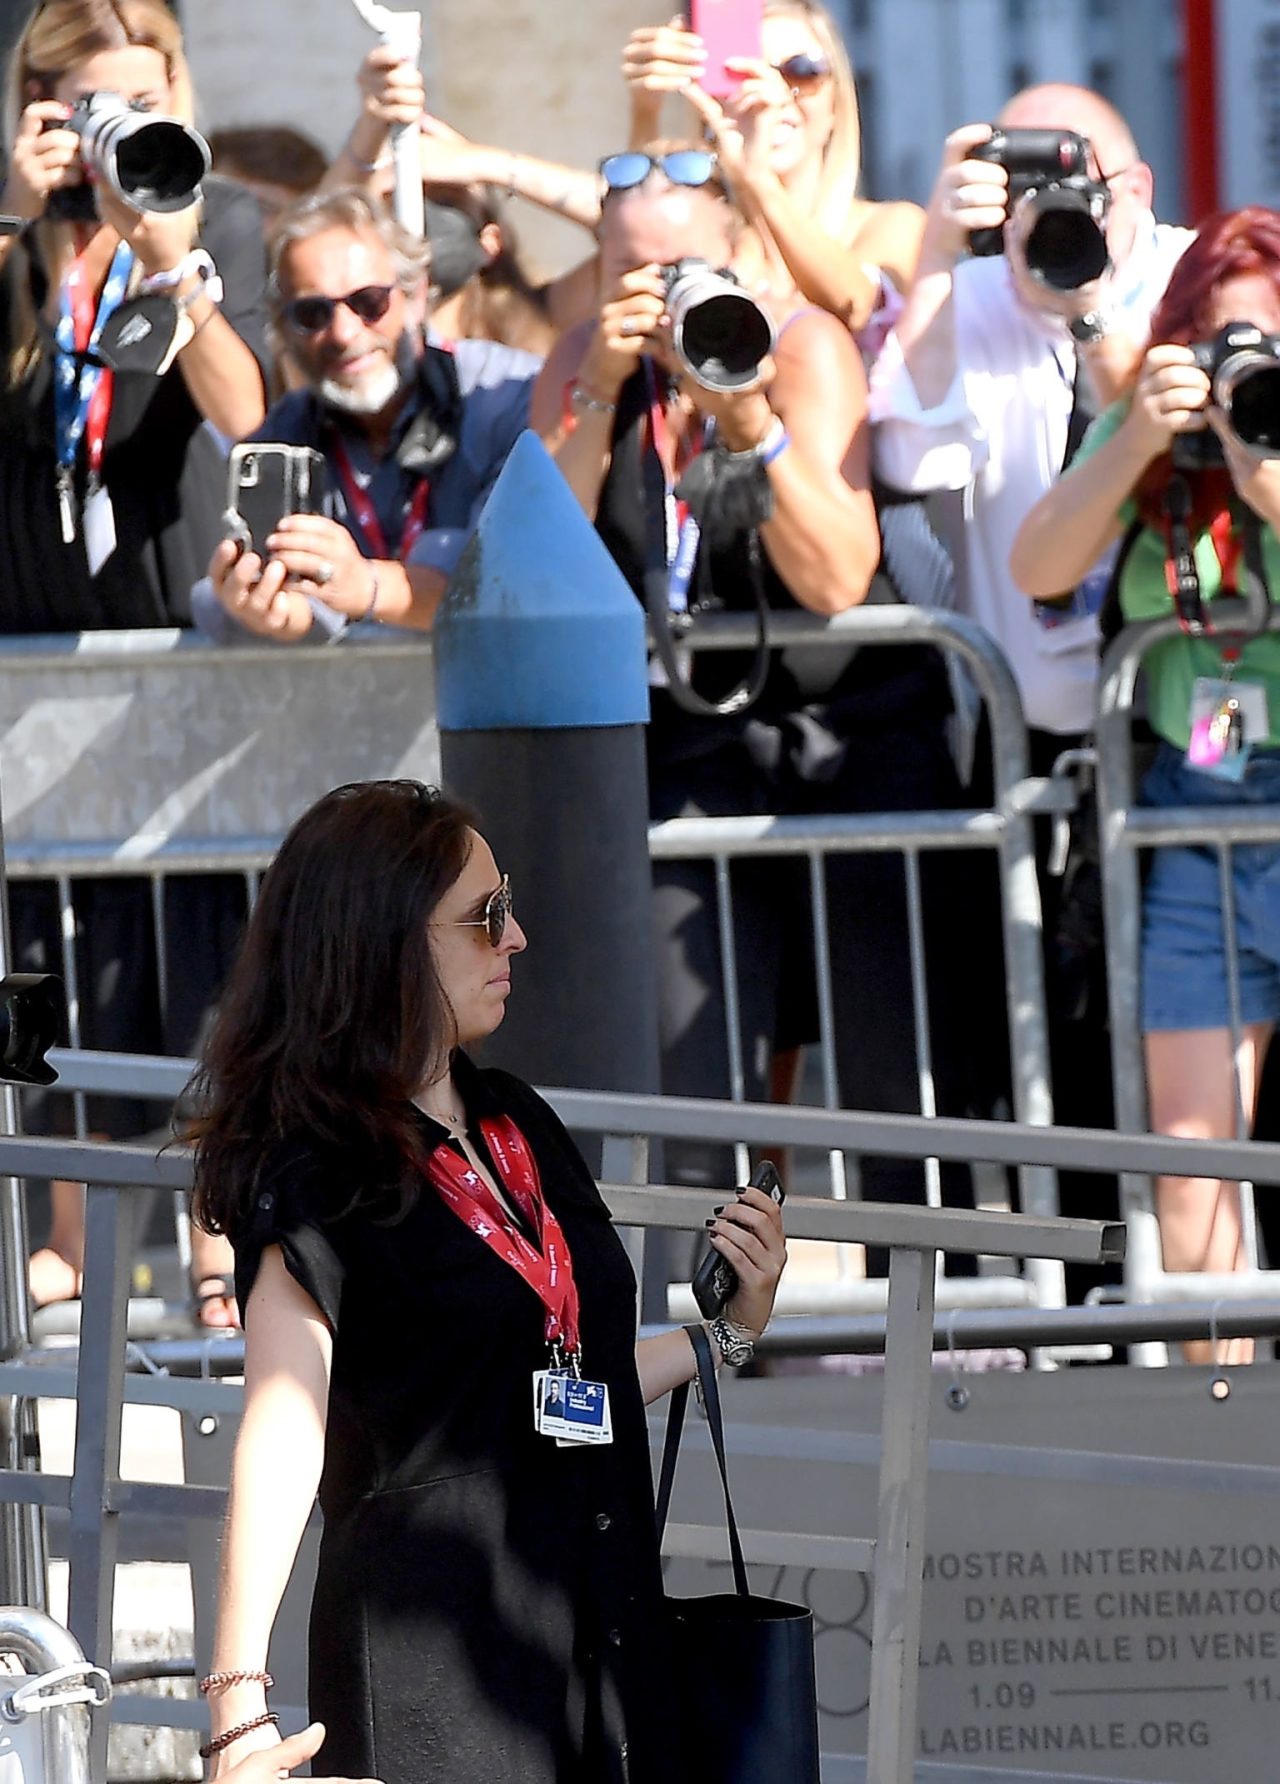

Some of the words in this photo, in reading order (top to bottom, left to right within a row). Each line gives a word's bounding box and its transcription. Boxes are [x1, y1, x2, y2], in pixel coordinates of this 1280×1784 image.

[964, 1593, 1082, 1623] D'ARTE
[918, 1640, 953, 1668] LA
[967, 1635, 1132, 1666] BIENNALE
[1146, 1634, 1177, 1661] DI
[968, 1682, 1035, 1709] 1.09
[919, 1720, 1209, 1755] LABIENNALE.ORG
